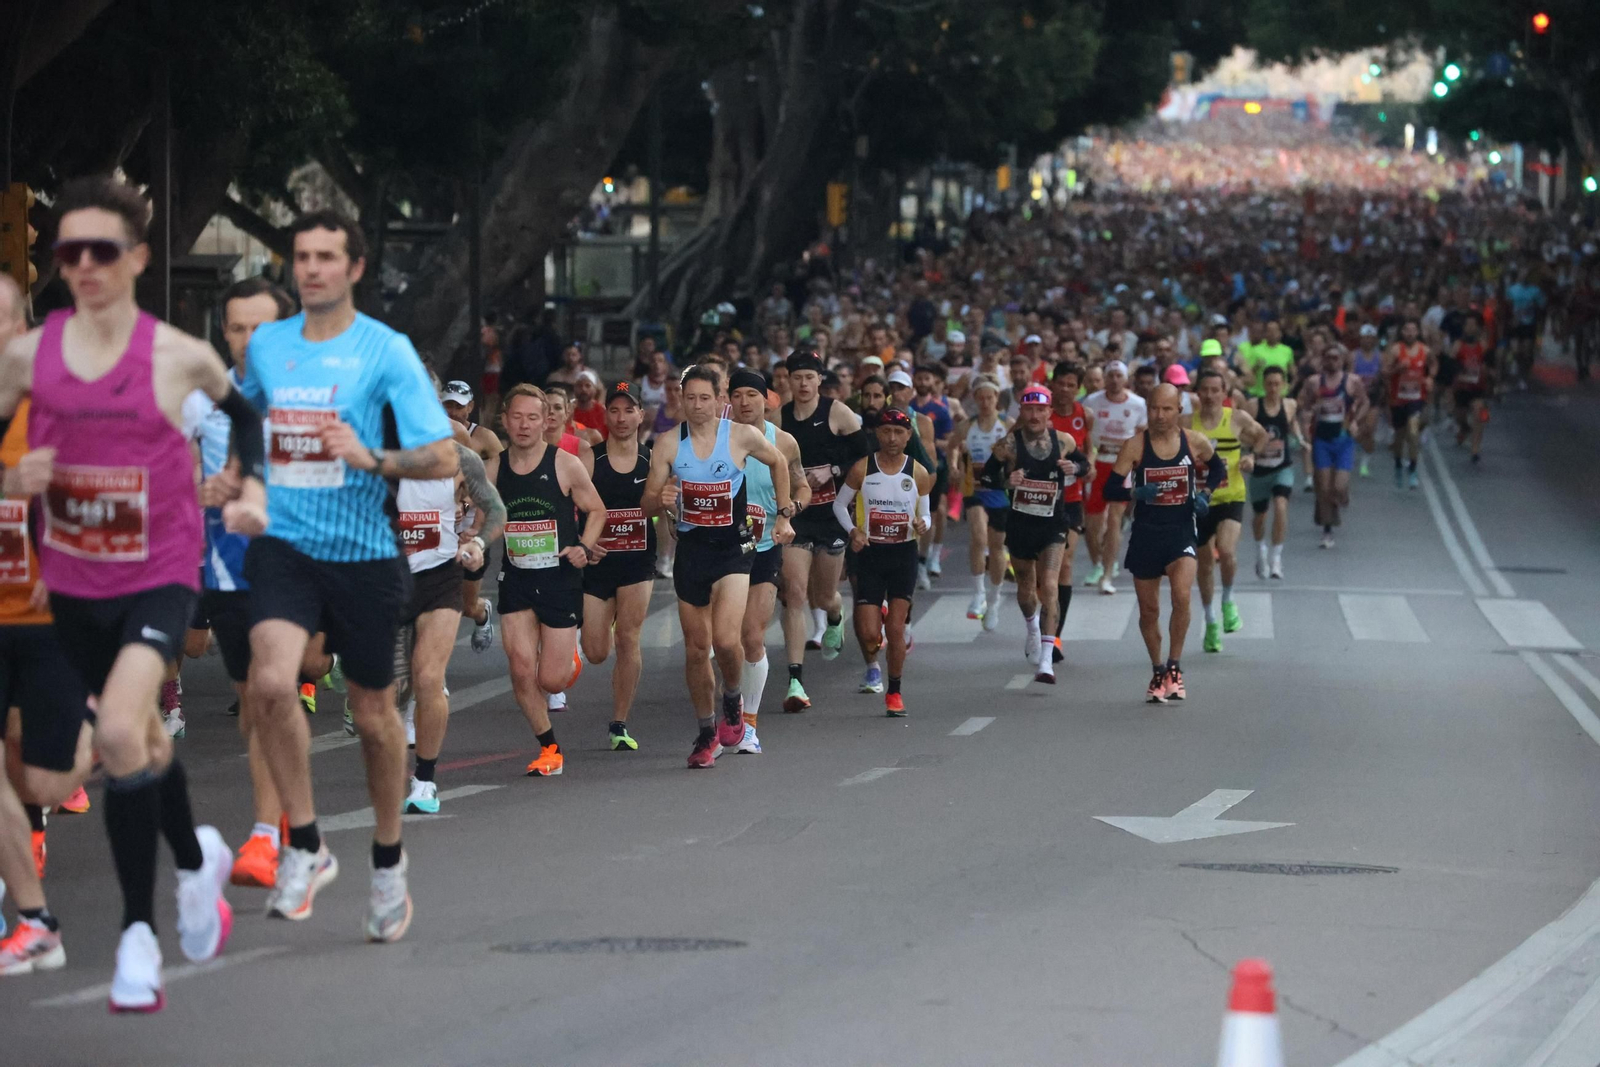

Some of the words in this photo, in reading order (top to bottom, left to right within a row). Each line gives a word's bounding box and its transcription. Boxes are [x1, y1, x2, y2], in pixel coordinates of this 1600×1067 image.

[693, 483, 729, 492] GENERALI
[693, 498, 718, 507] 3921
[610, 510, 643, 519] GENERALI
[517, 522, 553, 532] GENERALI
[610, 524, 634, 533] 7484
[880, 525, 900, 533] 1054
[516, 538, 547, 548] 18035
